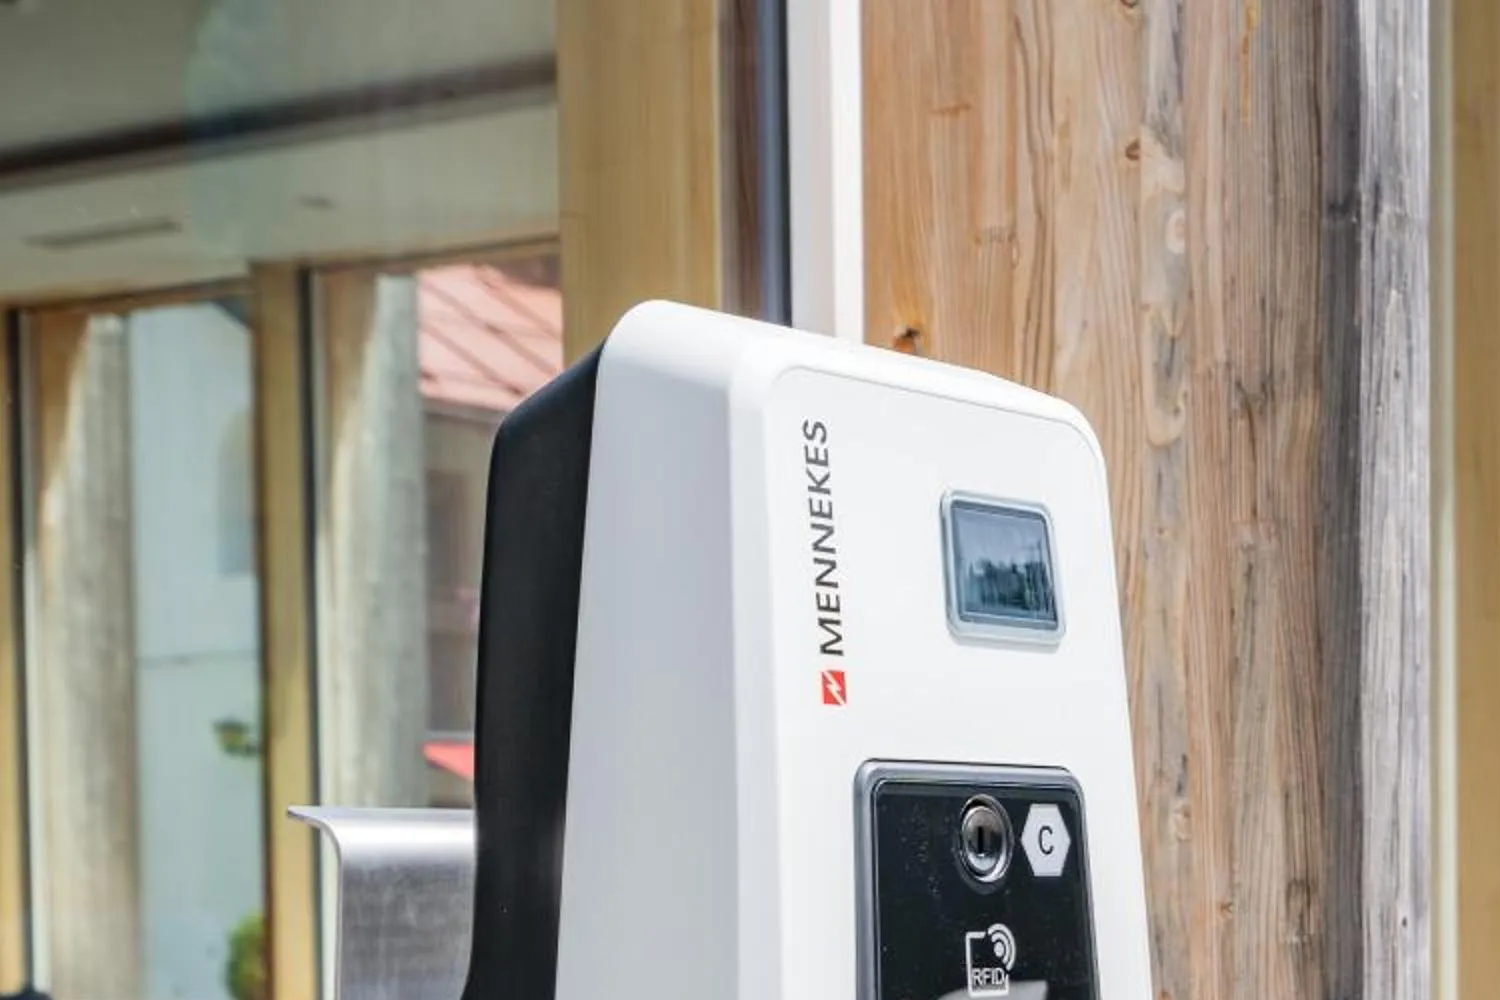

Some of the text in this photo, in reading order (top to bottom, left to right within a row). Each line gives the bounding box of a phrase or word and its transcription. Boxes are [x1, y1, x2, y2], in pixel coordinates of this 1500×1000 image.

[801, 419, 845, 656] MENNEKES
[1038, 825, 1054, 855] C
[971, 966, 1006, 986] RFID
